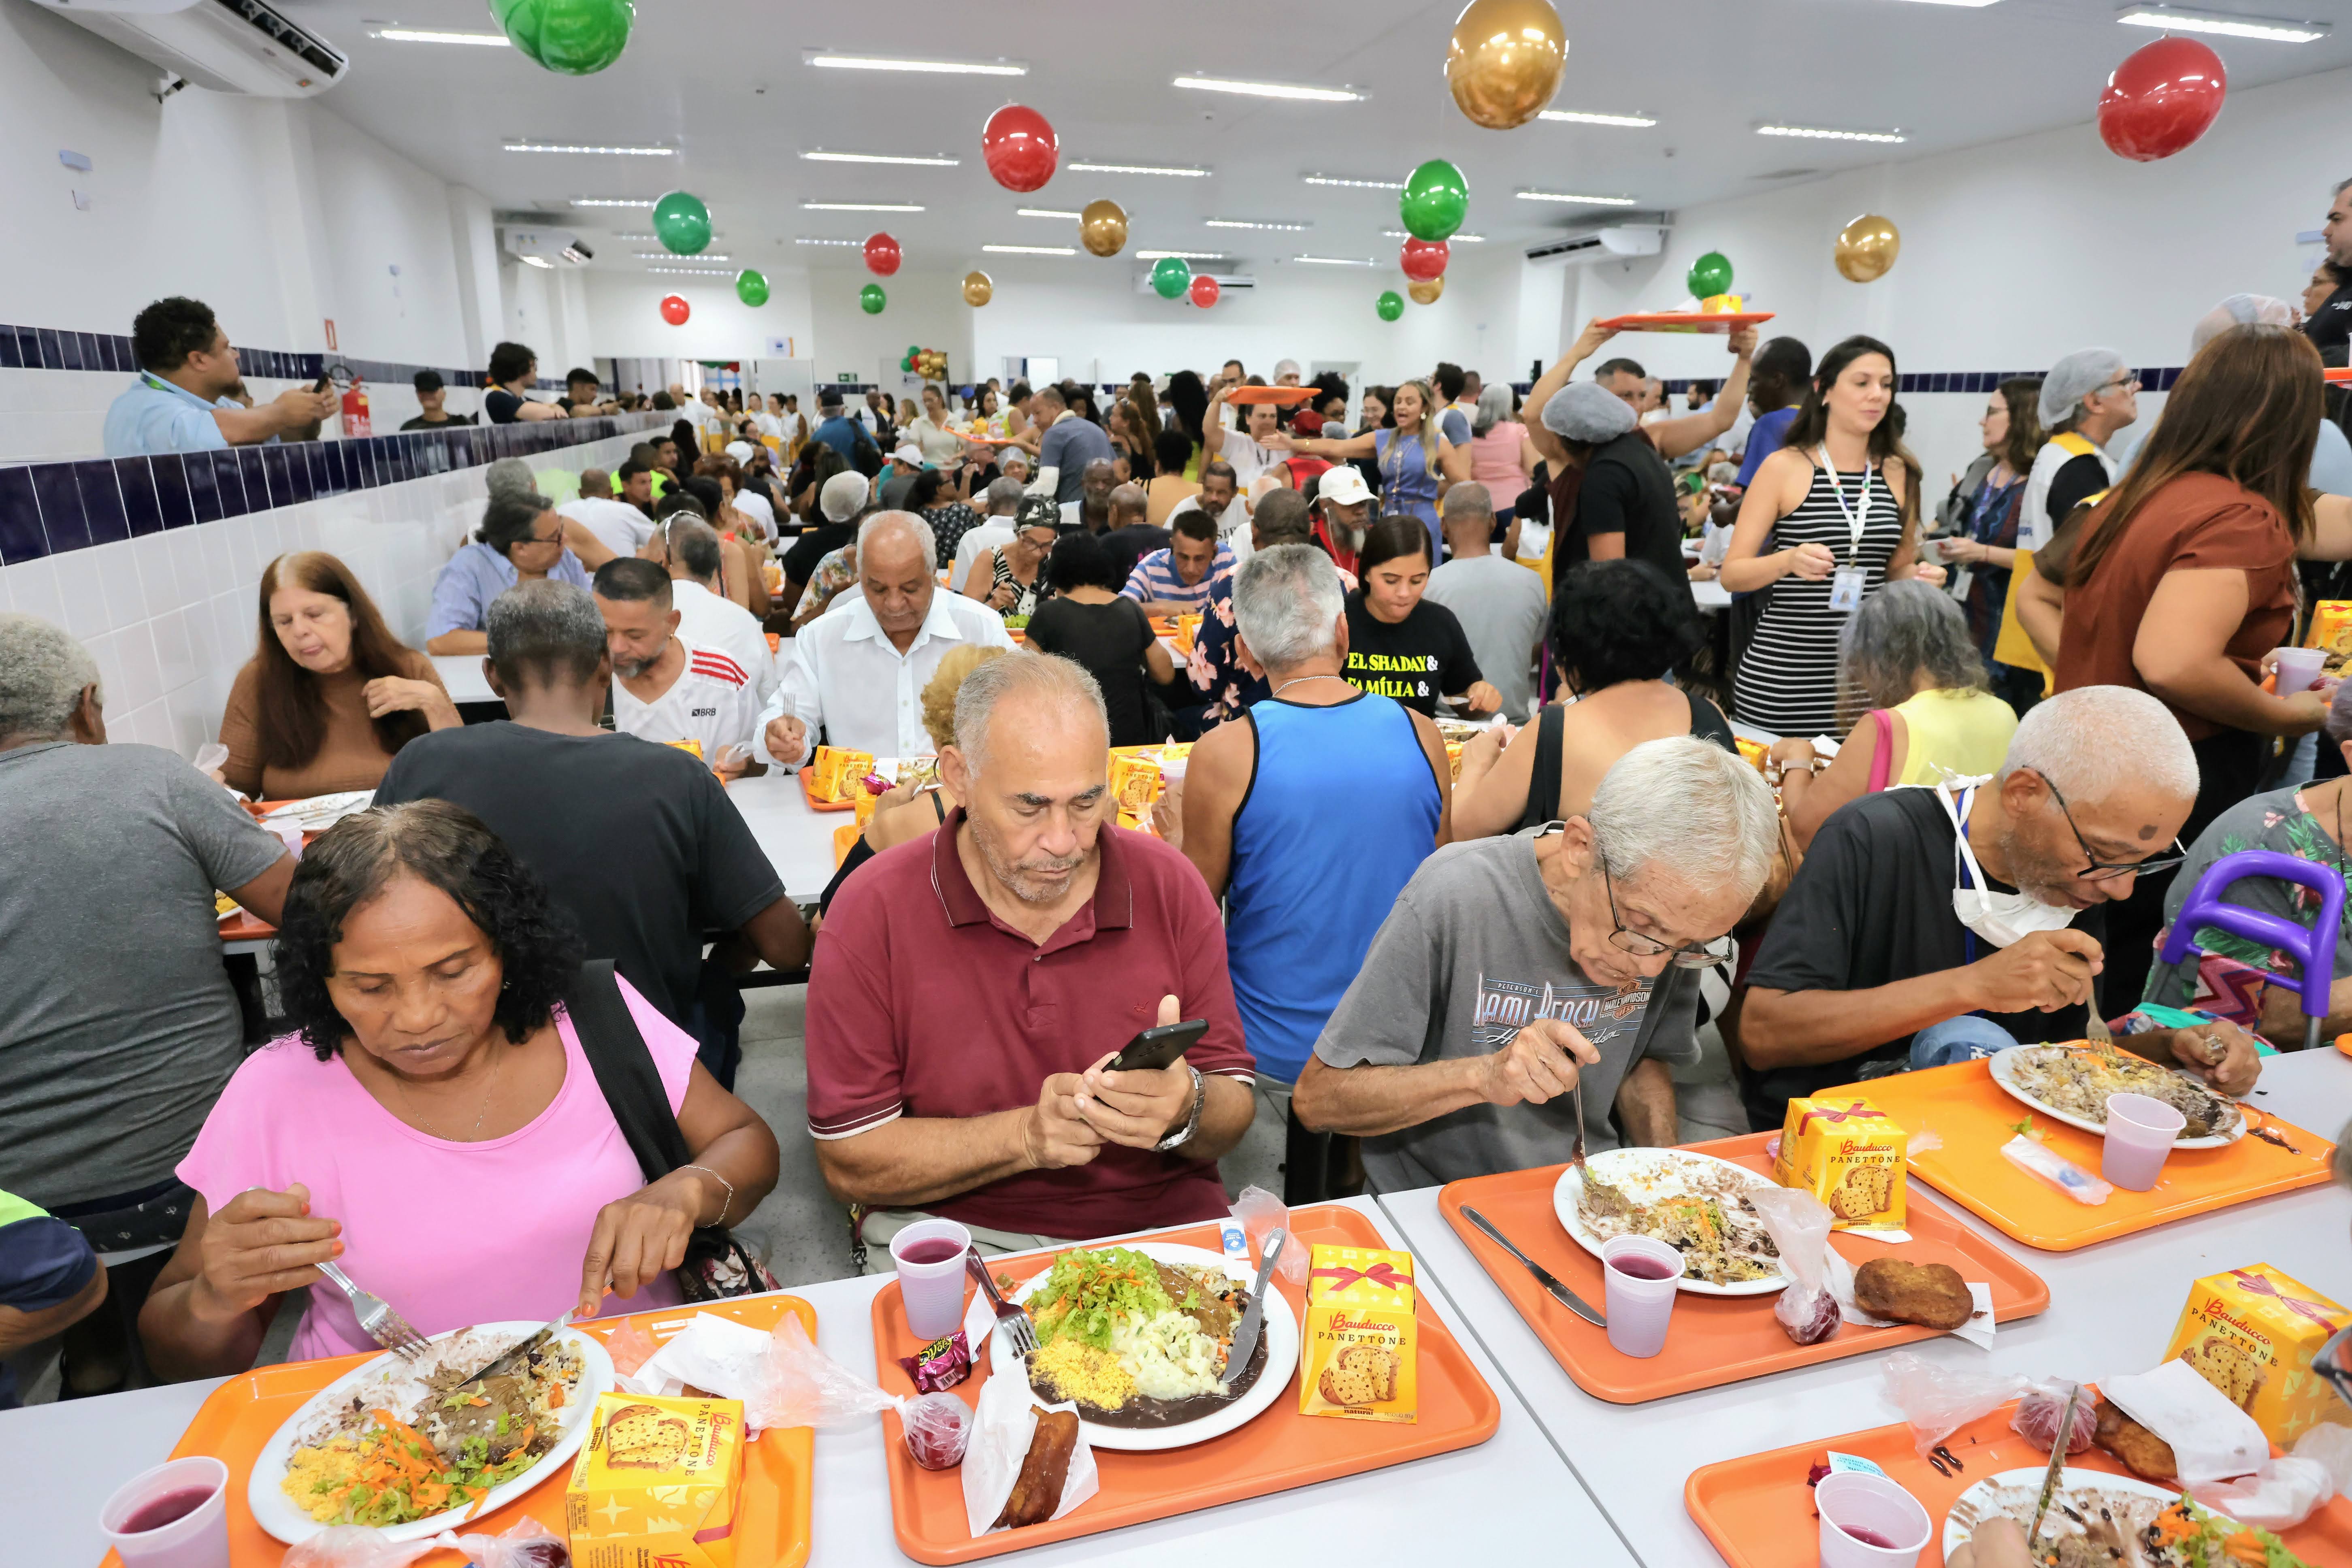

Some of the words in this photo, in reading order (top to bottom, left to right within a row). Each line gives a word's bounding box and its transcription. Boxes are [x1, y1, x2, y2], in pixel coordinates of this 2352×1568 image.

[1347, 652, 1367, 669] EL
[1417, 681, 1429, 697] &
[701, 708, 716, 716] BRB
[1122, 772, 1156, 780] PANETTONE
[1498, 982, 1539, 995] PETERSON'S
[1840, 1138, 1892, 1155] Bauducco
[1329, 1311, 1396, 1332] Bauducco
[2204, 1297, 2271, 1345] Bauducco
[1318, 1332, 1406, 1345] PANETTONE
[2191, 1308, 2278, 1367] PANETTONE
[588, 1426, 601, 1451] natural
[685, 1404, 710, 1476] PANETTONE
[706, 1412, 735, 1467] Bauducco
